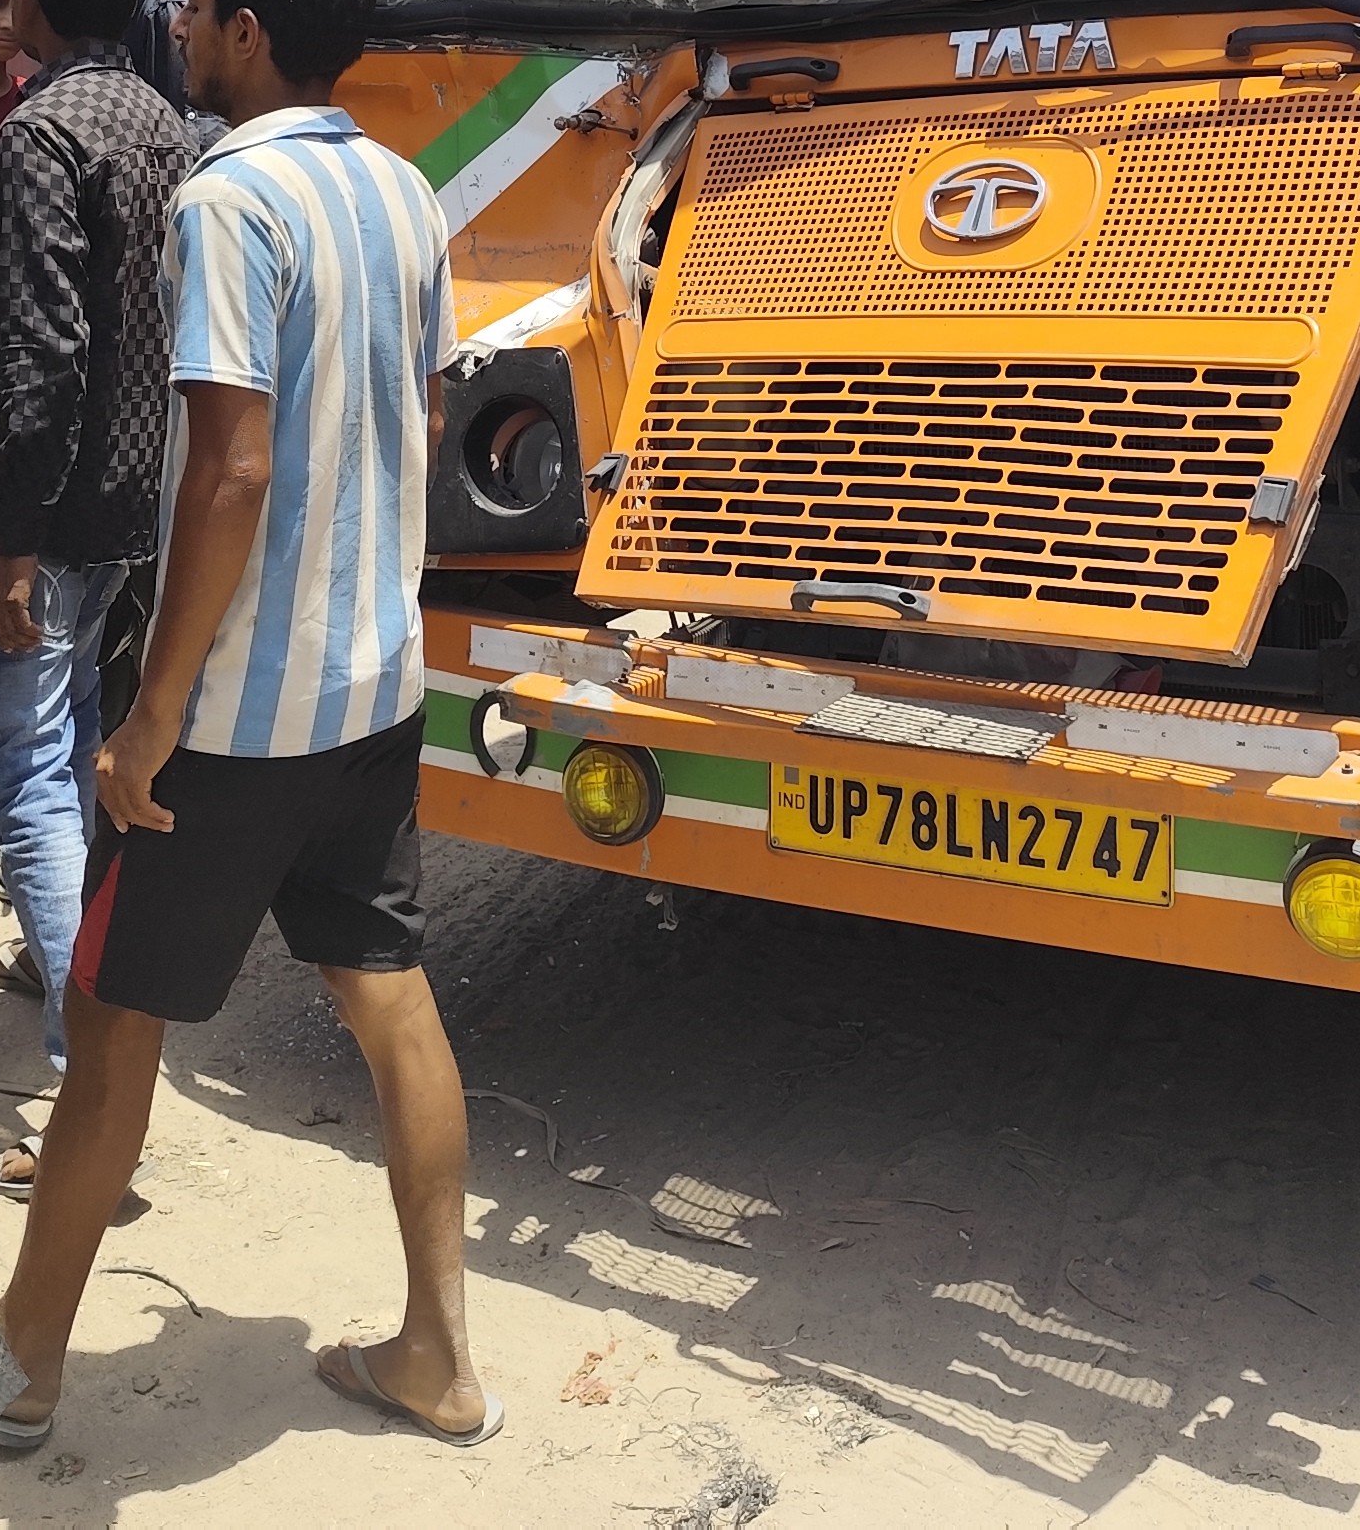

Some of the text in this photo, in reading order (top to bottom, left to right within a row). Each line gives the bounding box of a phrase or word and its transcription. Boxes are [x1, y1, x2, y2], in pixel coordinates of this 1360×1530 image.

[948, 19, 1117, 79] TATA
[778, 774, 1160, 882] IND UP78LN2747
